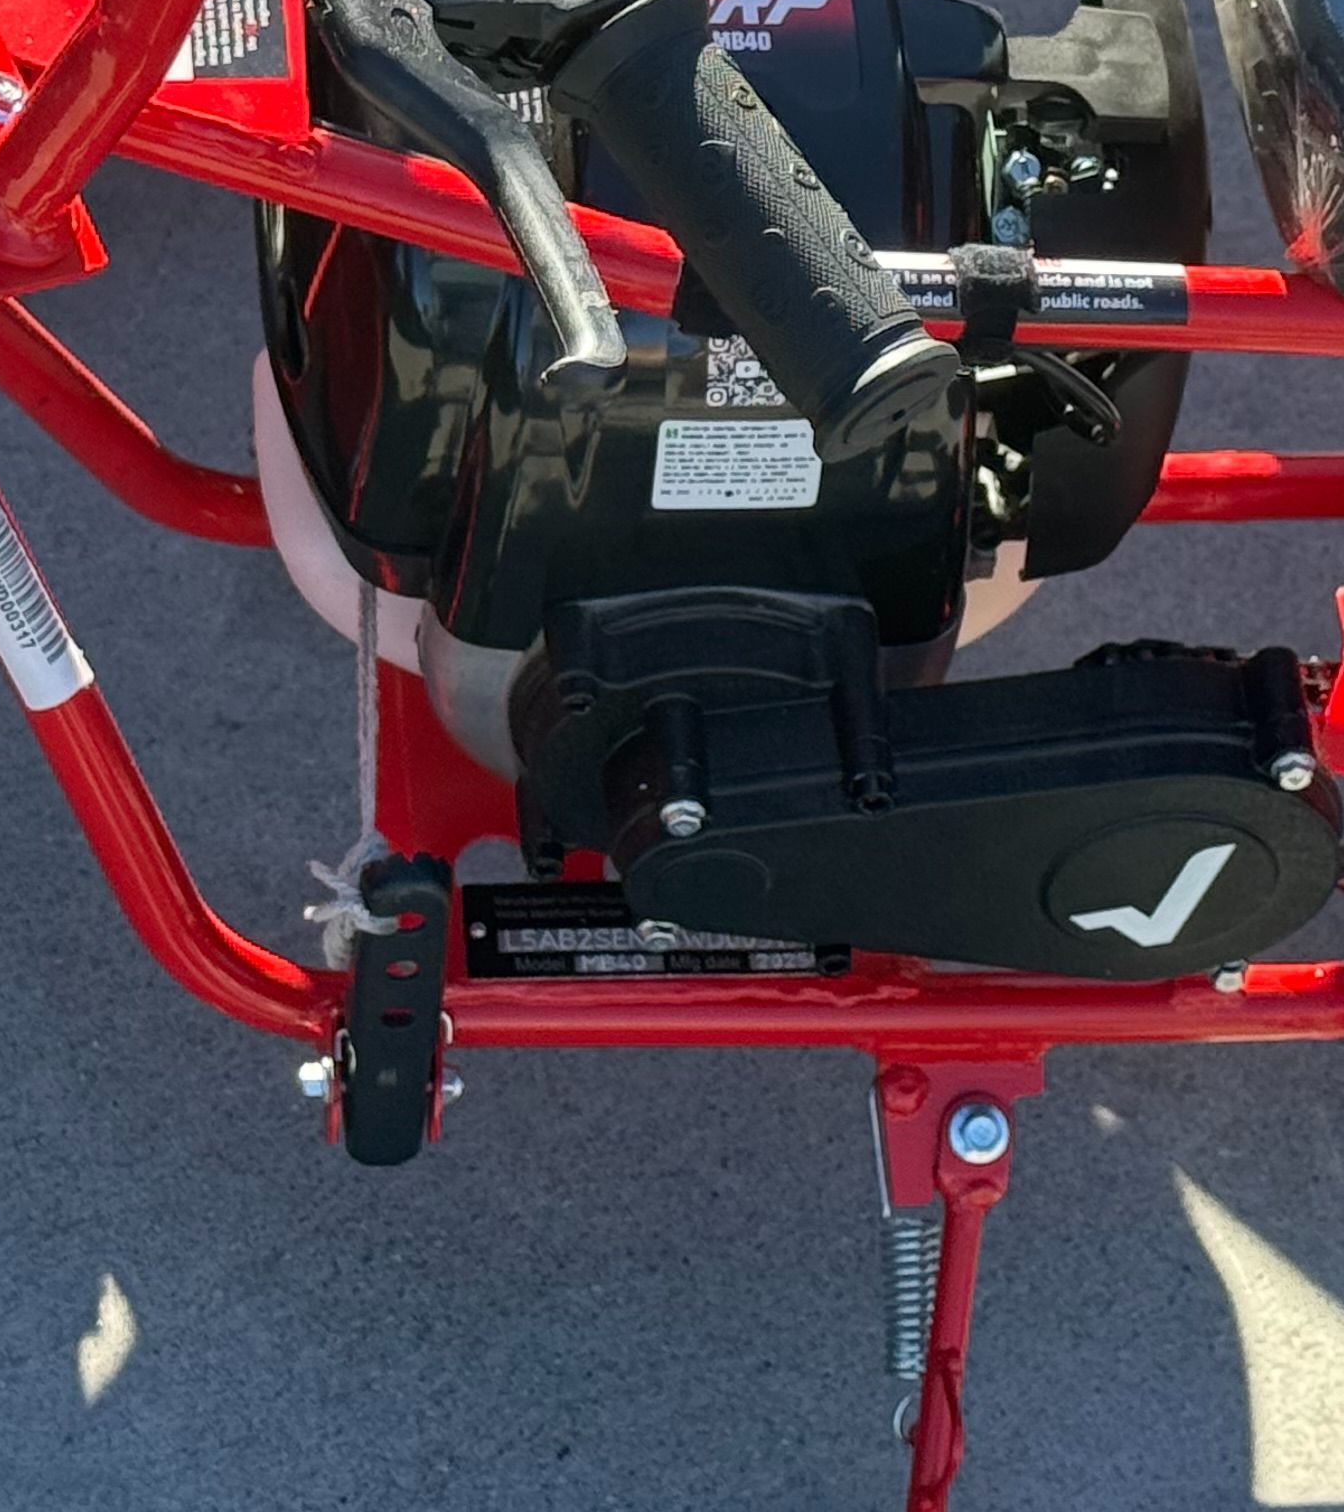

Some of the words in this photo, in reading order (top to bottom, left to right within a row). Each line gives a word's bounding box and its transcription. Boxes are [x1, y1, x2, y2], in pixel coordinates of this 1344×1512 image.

[712, 29, 772, 52] MB40
[1040, 291, 1089, 313] public
[1093, 292, 1145, 310] roads.
